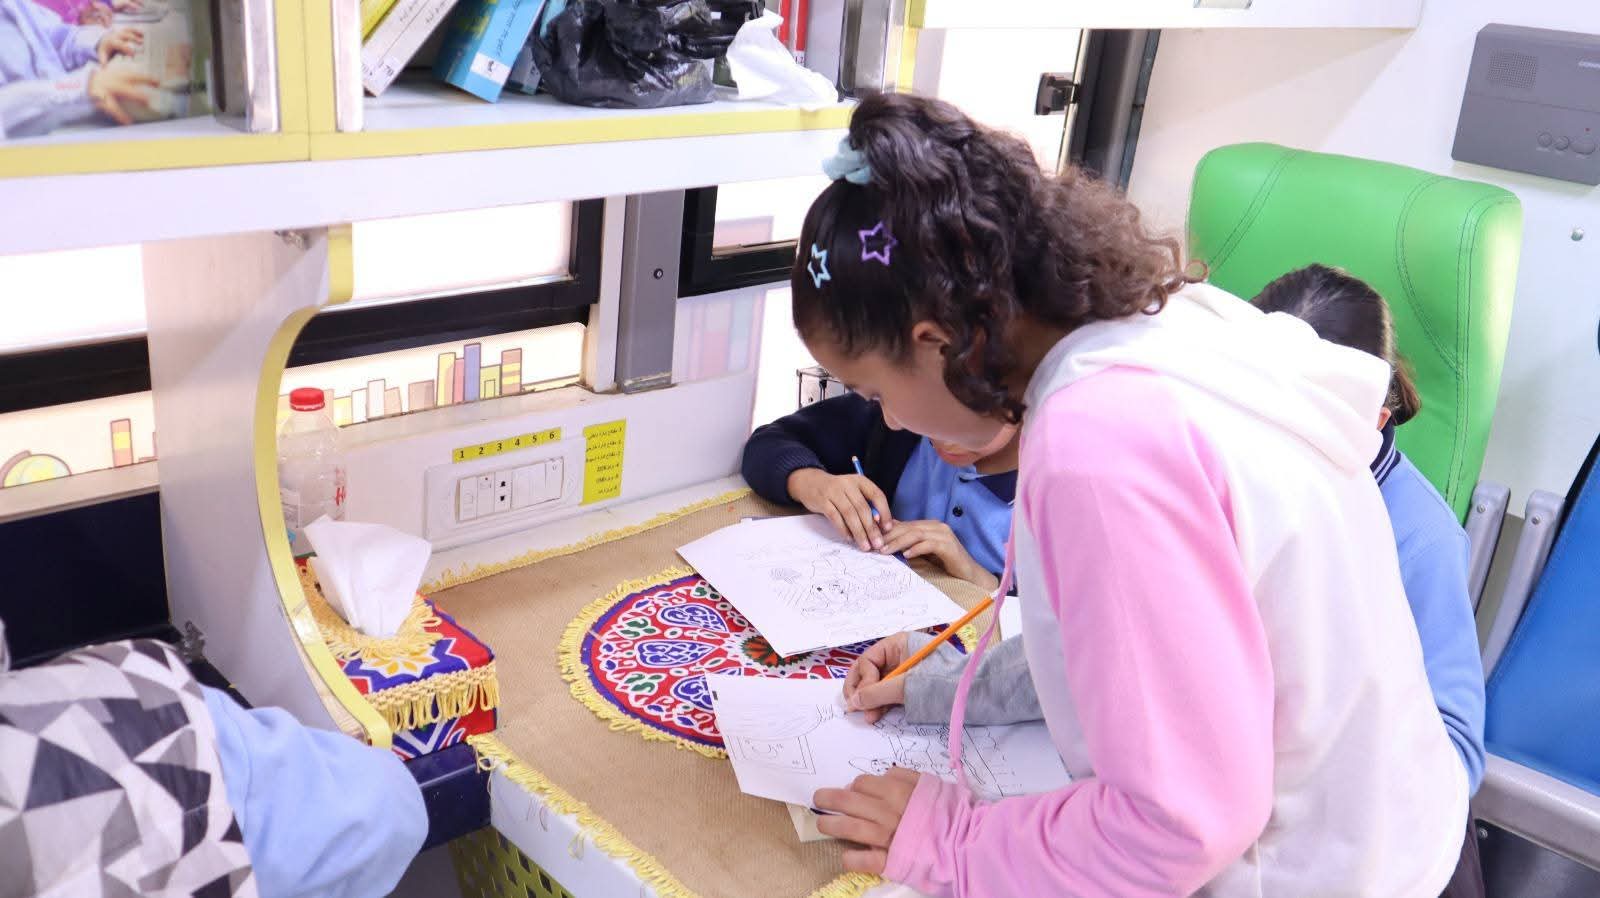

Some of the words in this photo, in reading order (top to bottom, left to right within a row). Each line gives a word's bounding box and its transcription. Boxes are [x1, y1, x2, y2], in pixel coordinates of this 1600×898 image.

[459, 450, 465, 458] 1
[478, 446, 484, 455] 2
[497, 443, 503, 451] 3
[514, 438, 521, 447] 4
[532, 435, 538, 443] 5
[549, 431, 555, 440] 6
